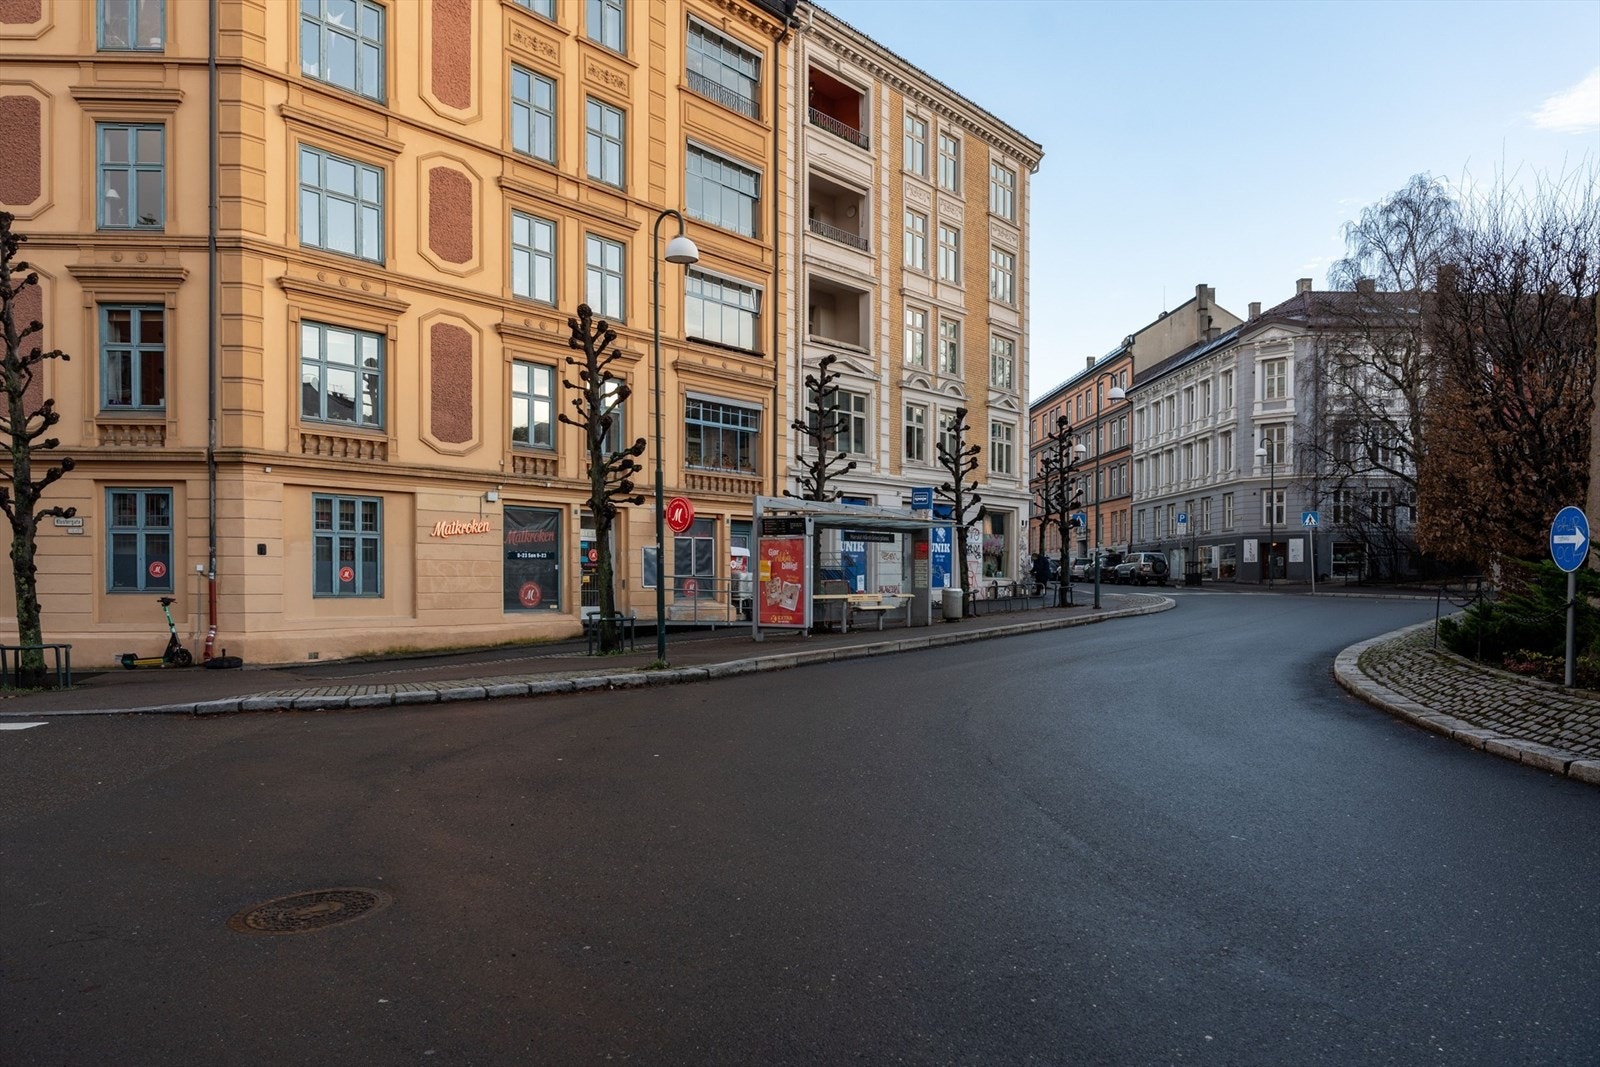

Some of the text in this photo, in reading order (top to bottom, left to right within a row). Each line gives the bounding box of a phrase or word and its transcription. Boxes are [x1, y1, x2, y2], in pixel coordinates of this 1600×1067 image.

[672, 508, 683, 523] M
[430, 518, 490, 539] Matkroken
[504, 529, 556, 546] Matkroken
[840, 541, 865, 552] UNIK
